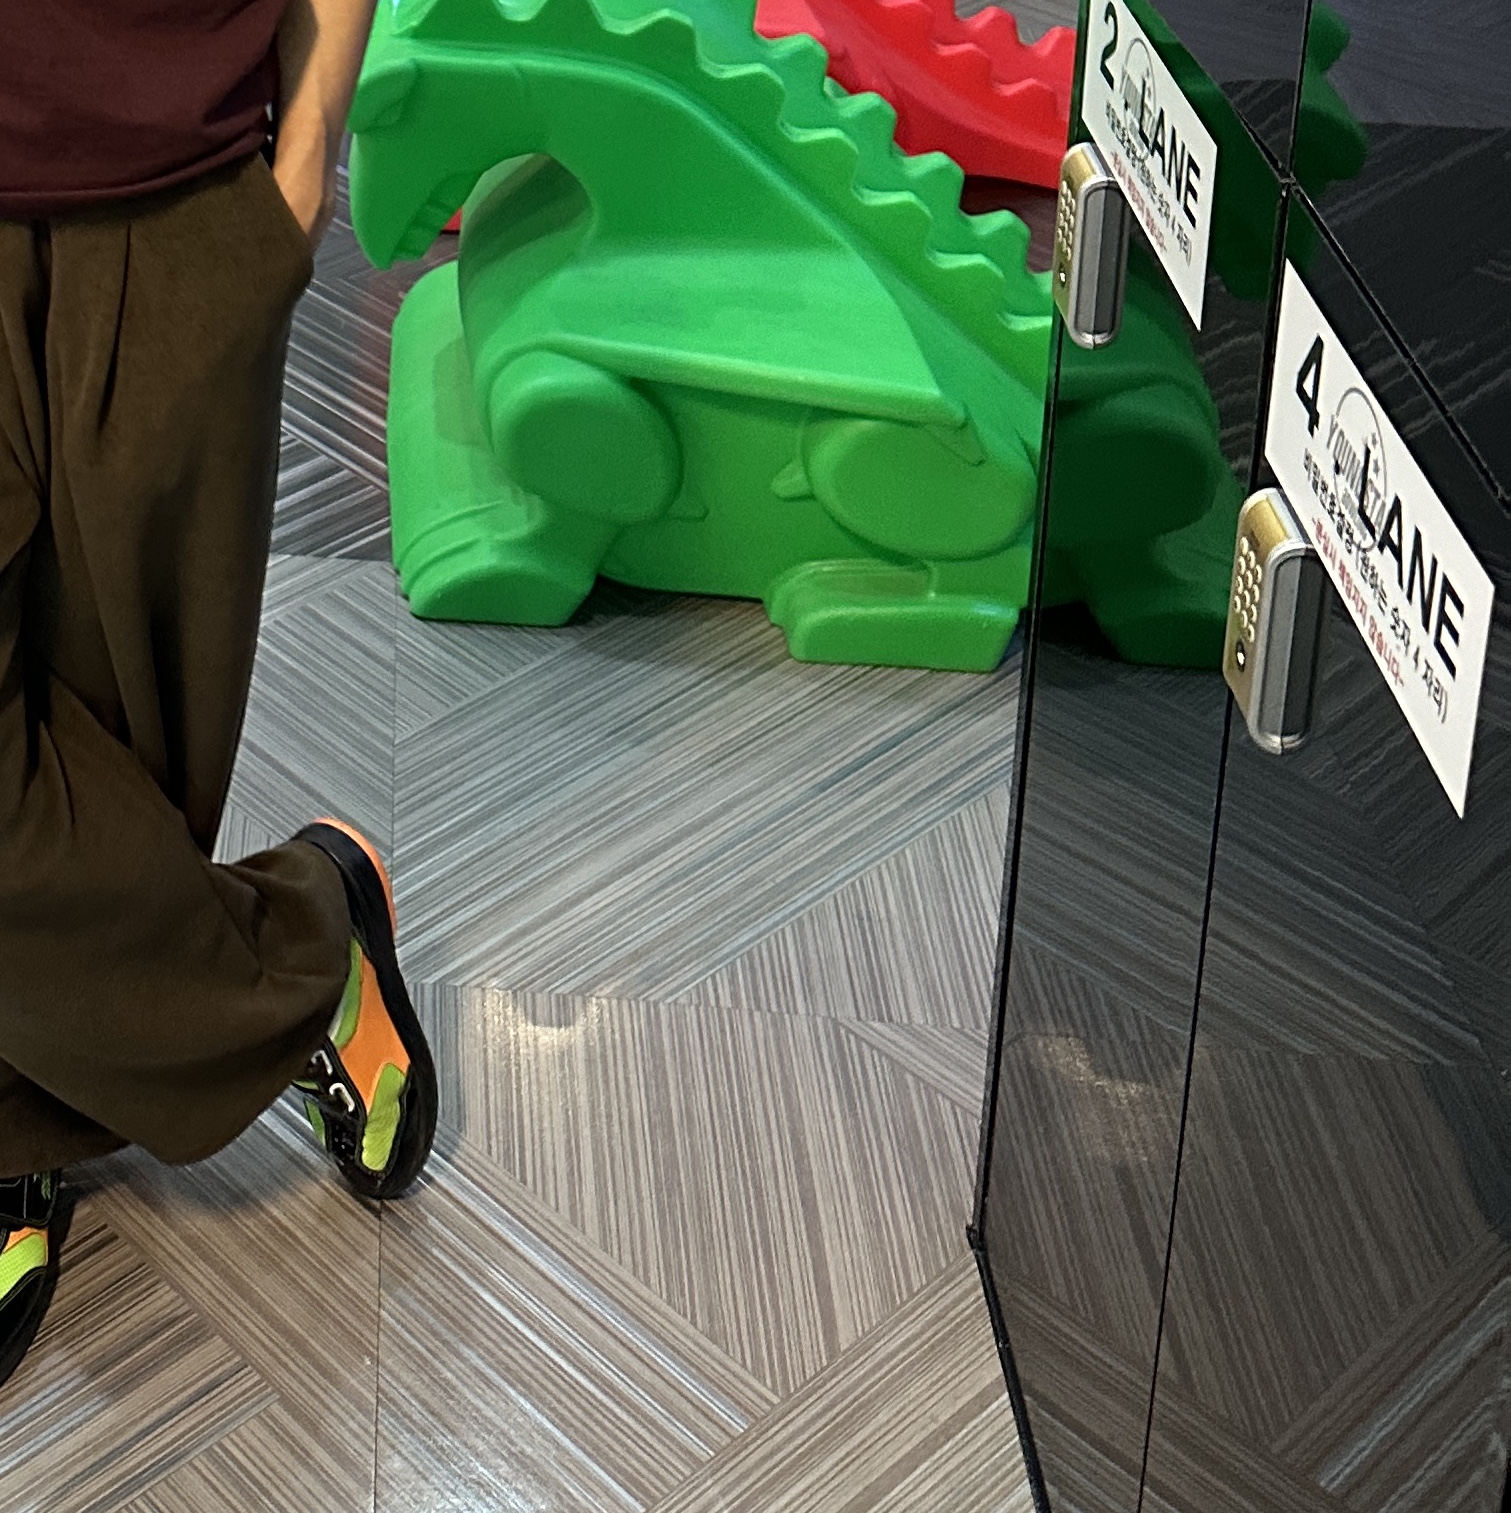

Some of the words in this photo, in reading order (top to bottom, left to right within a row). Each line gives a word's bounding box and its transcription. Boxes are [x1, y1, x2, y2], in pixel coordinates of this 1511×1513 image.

[1100, 0, 1119, 90] 2
[1139, 75, 1201, 230] LANE
[1296, 333, 1324, 439] 4
[1357, 441, 1465, 682] LANE
[1390, 606, 1411, 657] 숫자
